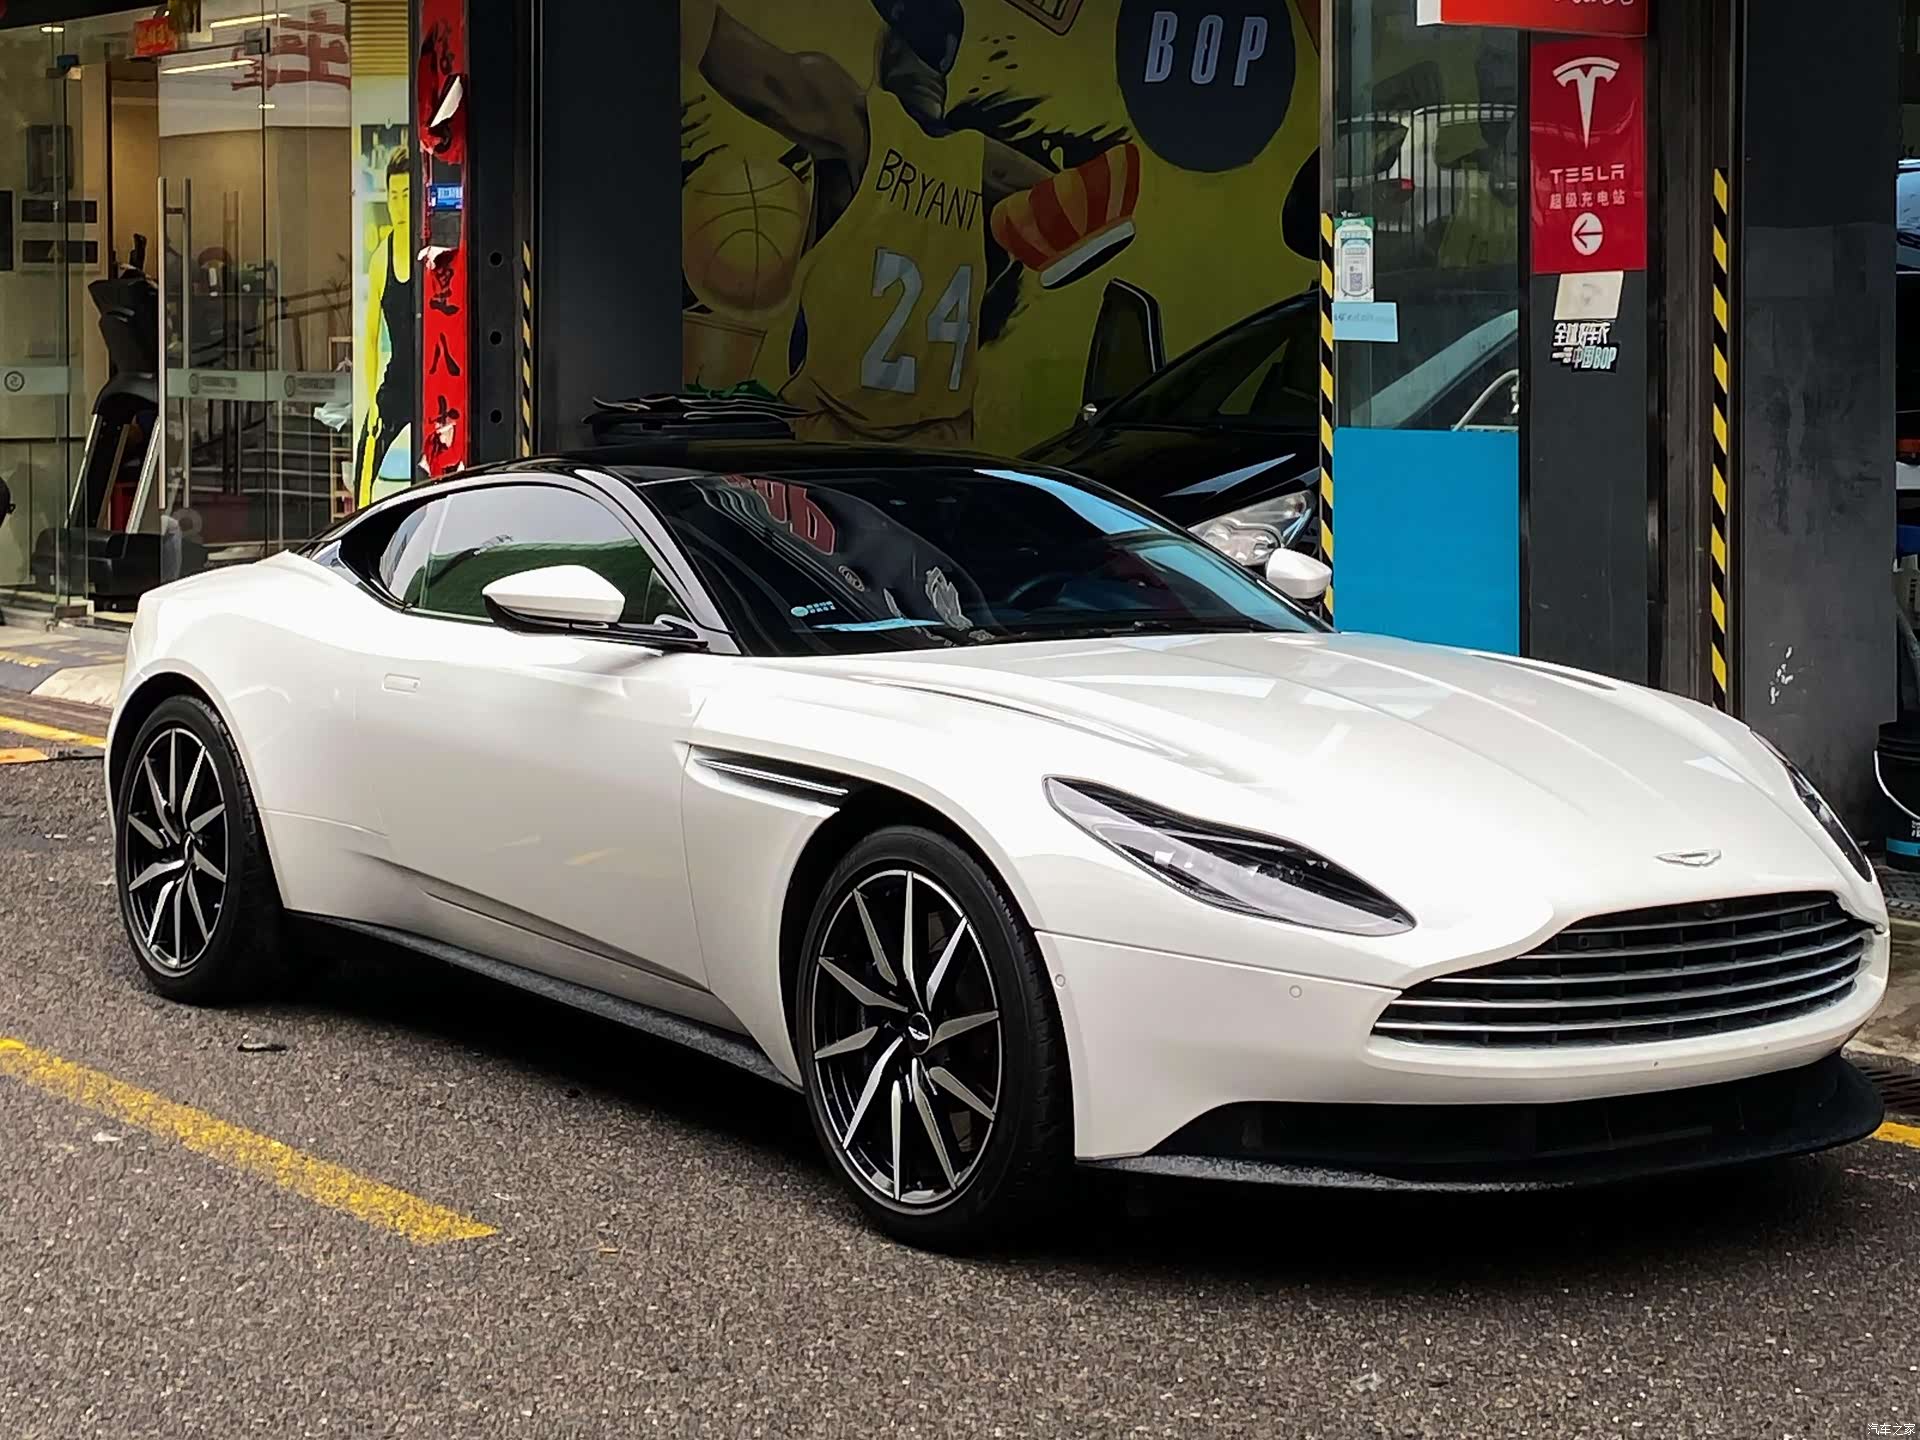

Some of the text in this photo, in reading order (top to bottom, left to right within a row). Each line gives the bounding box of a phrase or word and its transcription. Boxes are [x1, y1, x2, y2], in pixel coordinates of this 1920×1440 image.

[1144, 11, 1268, 86] BOP
[876, 149, 982, 231] BRYANT
[1549, 164, 1625, 185] TESLA
[1549, 189, 1625, 210] 超级充电站
[860, 247, 972, 395] 24
